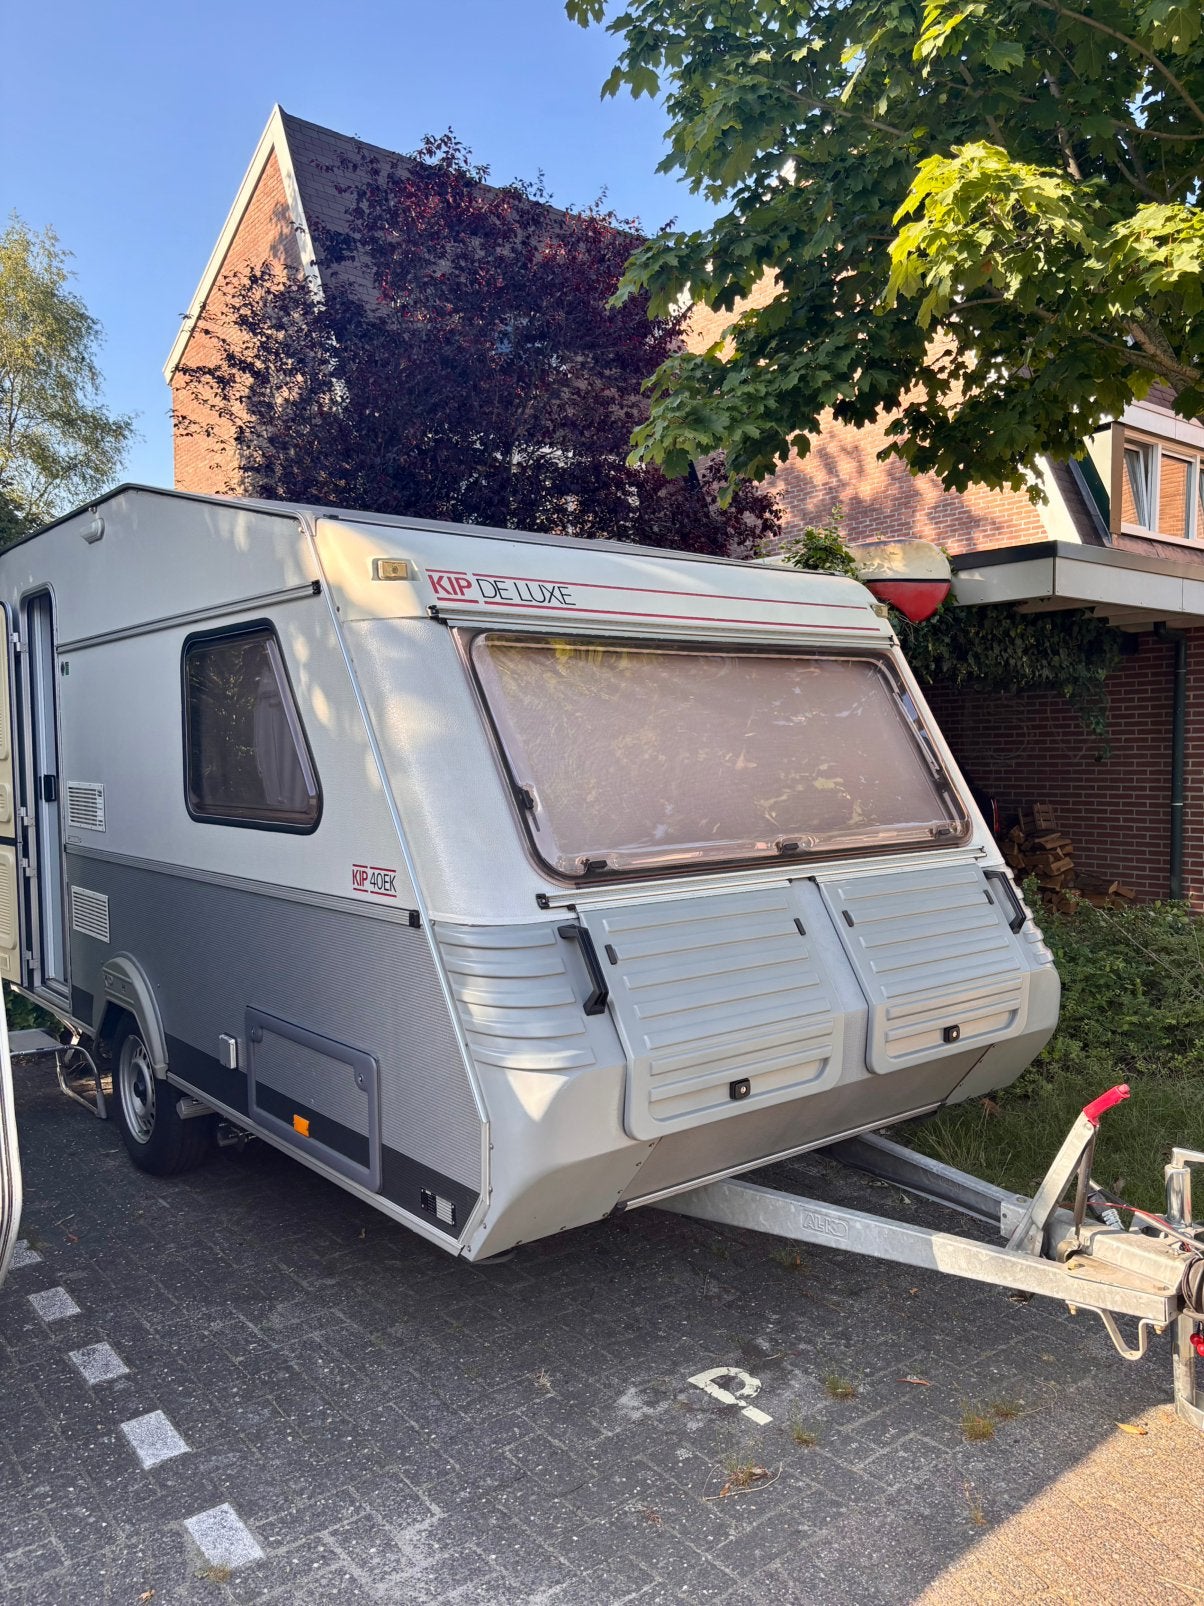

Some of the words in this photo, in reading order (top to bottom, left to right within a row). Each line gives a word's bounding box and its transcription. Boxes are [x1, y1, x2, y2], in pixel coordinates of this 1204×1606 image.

[428, 574, 472, 596] KIP
[476, 578, 513, 601] DE
[514, 582, 576, 605] LUXE
[352, 869, 368, 887] KIP
[370, 872, 397, 892] 40EK
